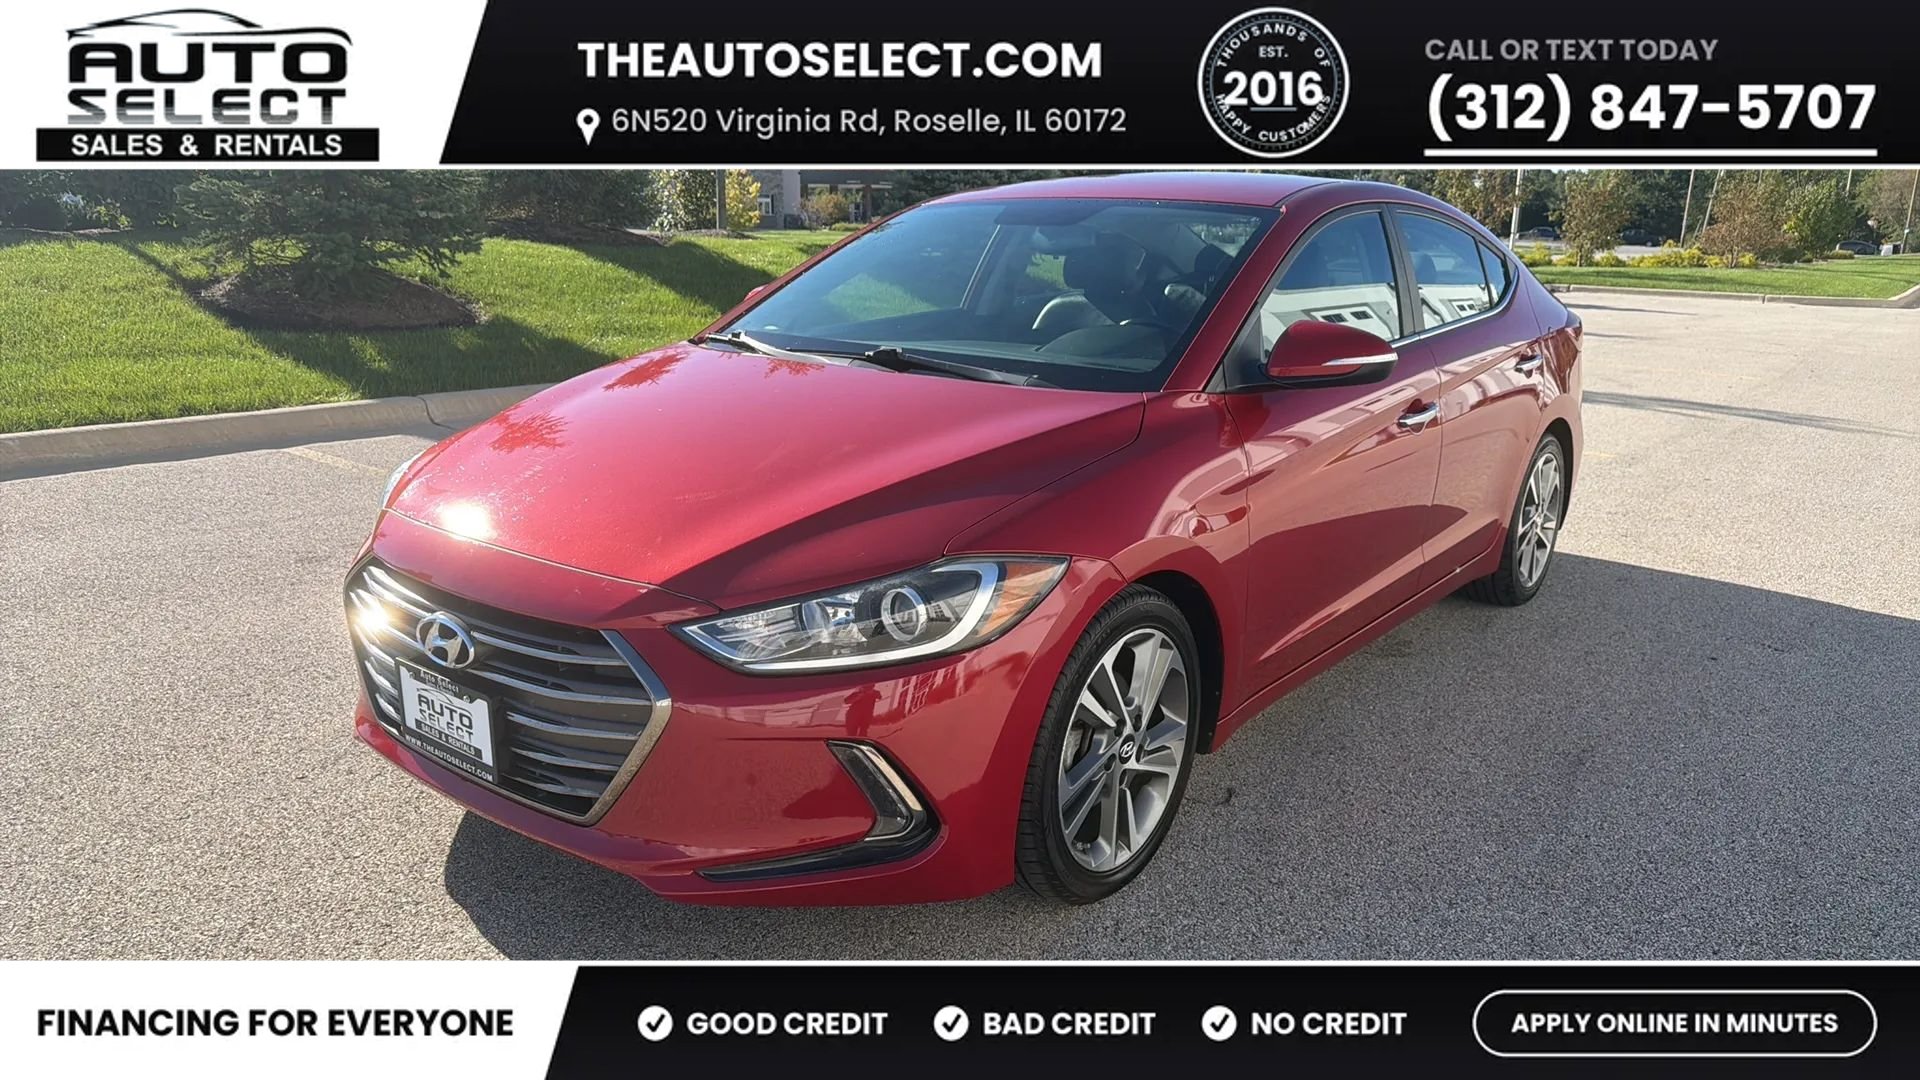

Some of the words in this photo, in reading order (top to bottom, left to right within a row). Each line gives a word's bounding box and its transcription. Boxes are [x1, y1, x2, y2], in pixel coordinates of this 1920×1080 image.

[437, 677, 459, 693] Select
[418, 693, 474, 730] AUTO
[418, 708, 474, 743] SELECT
[420, 722, 440, 739] SALES
[448, 737, 476, 755] RENTALS
[405, 734, 494, 781] WWW.THEAUTOSELECT.COM
